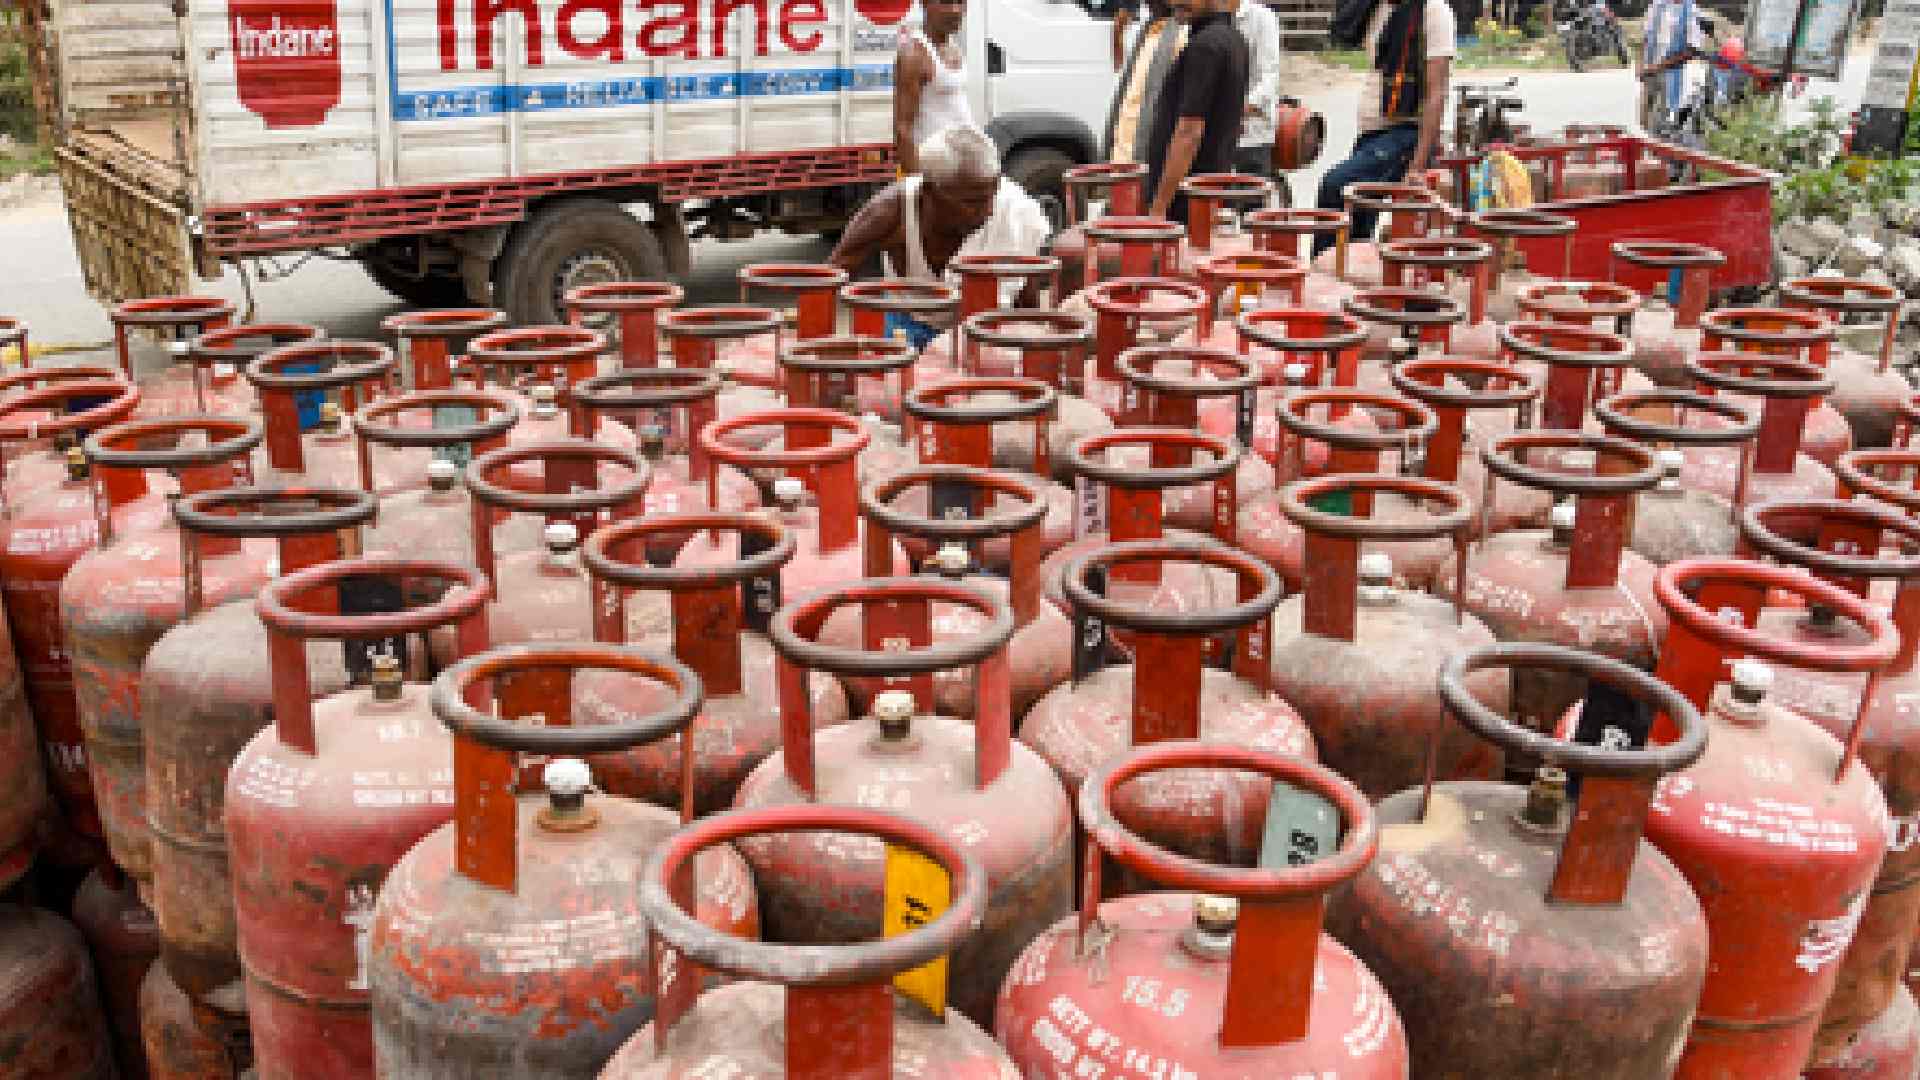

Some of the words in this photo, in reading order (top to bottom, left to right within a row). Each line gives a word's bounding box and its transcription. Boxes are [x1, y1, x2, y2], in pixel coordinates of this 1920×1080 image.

[236, 15, 333, 57] Indane
[437, 0, 827, 72] Indane
[1120, 975, 1191, 1020] 15.5
